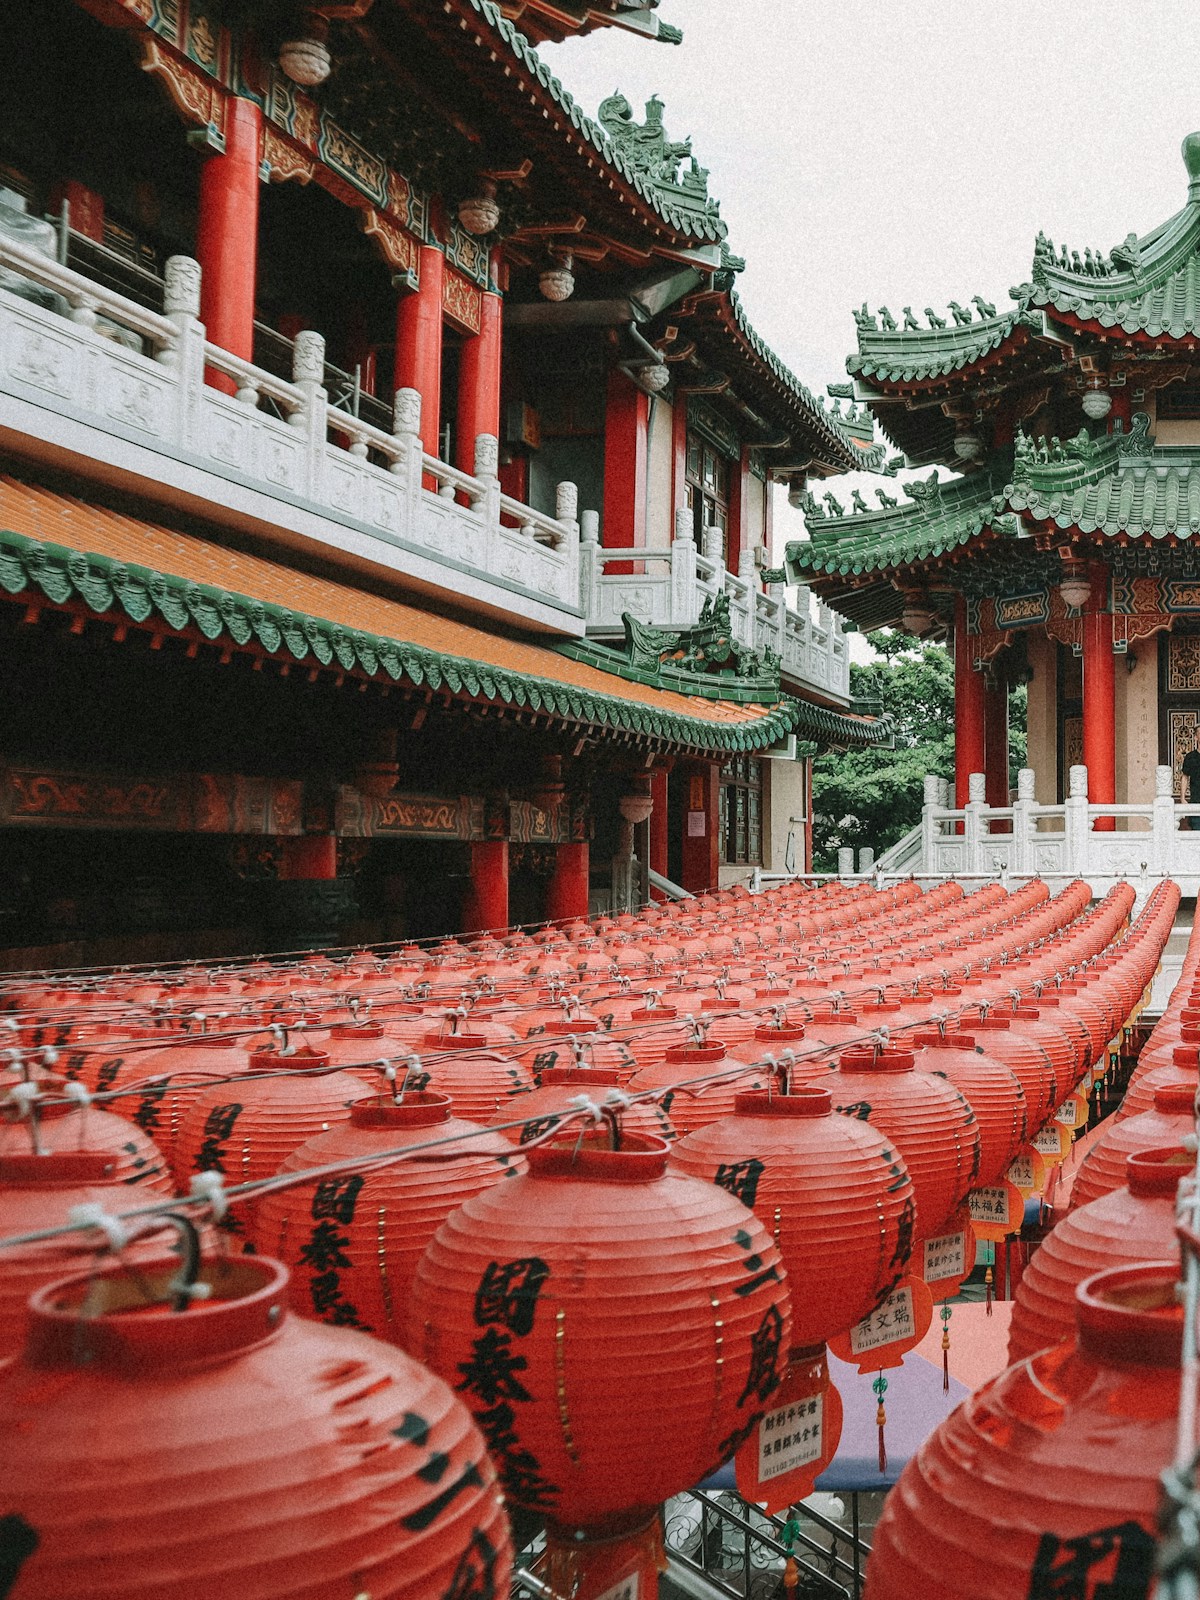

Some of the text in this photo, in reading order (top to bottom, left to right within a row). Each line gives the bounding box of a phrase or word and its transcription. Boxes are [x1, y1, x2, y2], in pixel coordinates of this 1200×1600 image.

[970, 1198, 1006, 1214] 林福鑫
[765, 1400, 818, 1432] 財利平安燈
